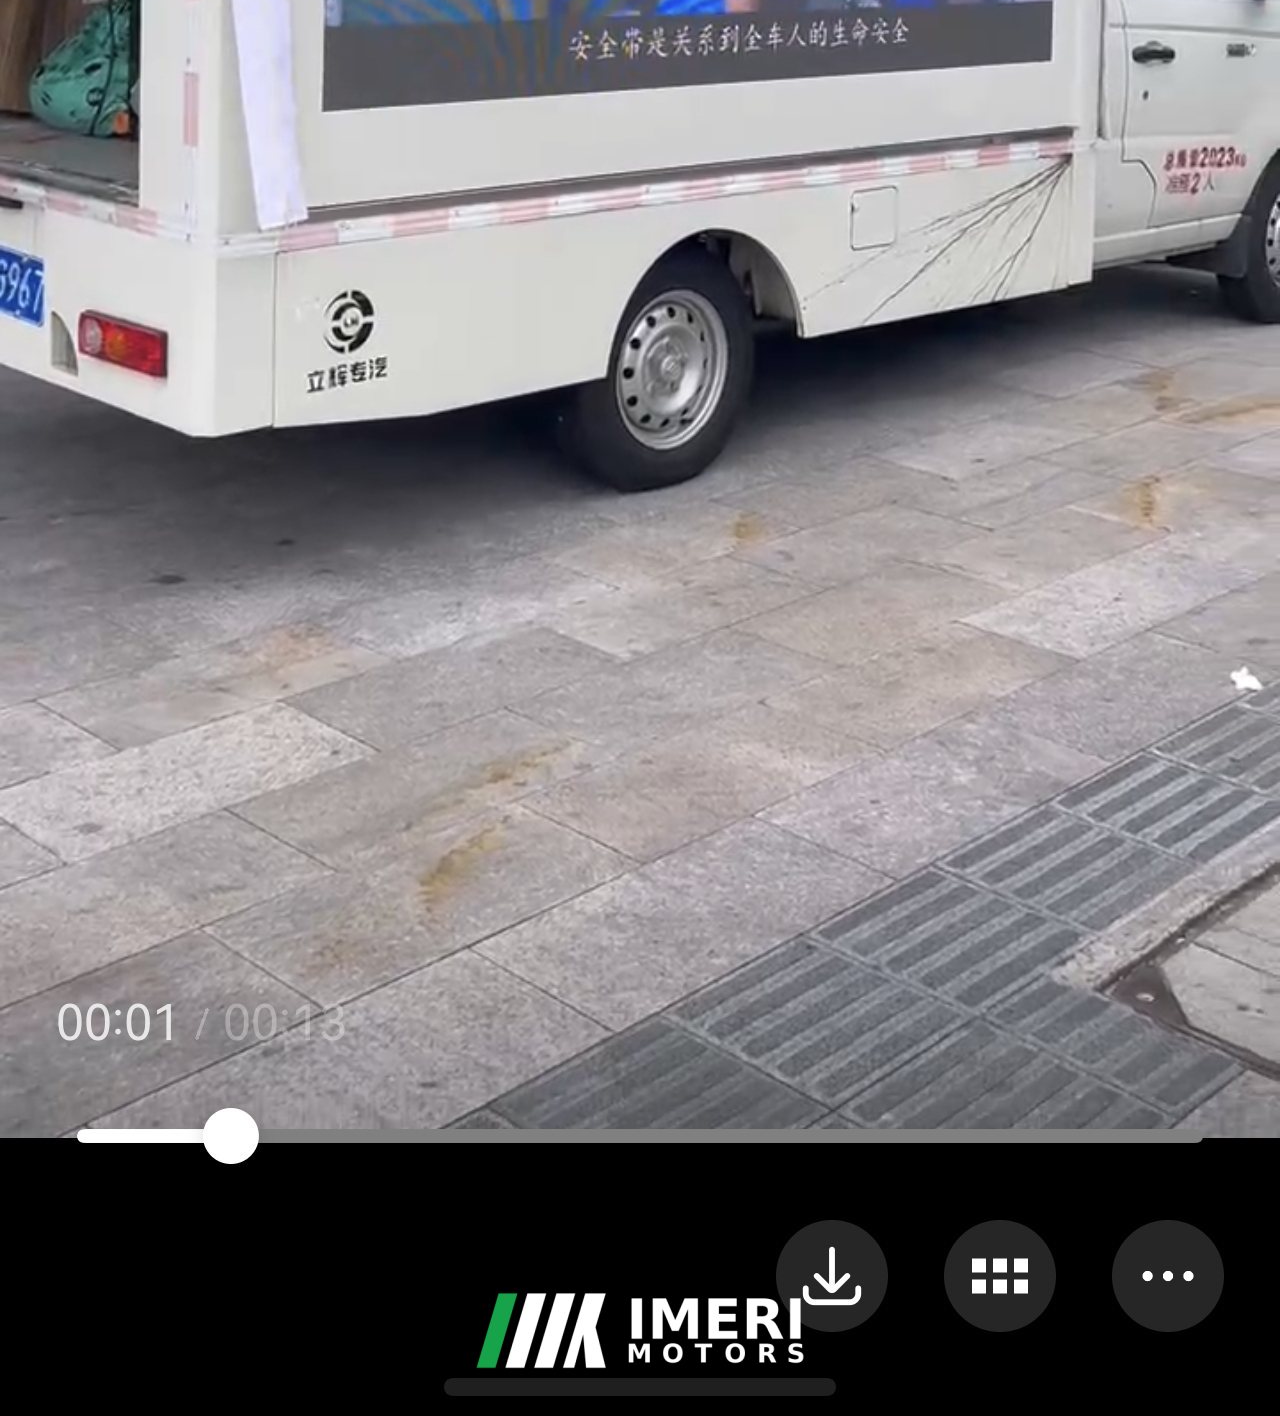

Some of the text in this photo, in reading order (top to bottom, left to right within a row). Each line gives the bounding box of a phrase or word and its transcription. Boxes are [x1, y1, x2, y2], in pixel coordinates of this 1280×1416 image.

[568, 16, 911, 62] 安全带是关系到全车人的生命安全
[306, 356, 388, 394] 立辉专汽
